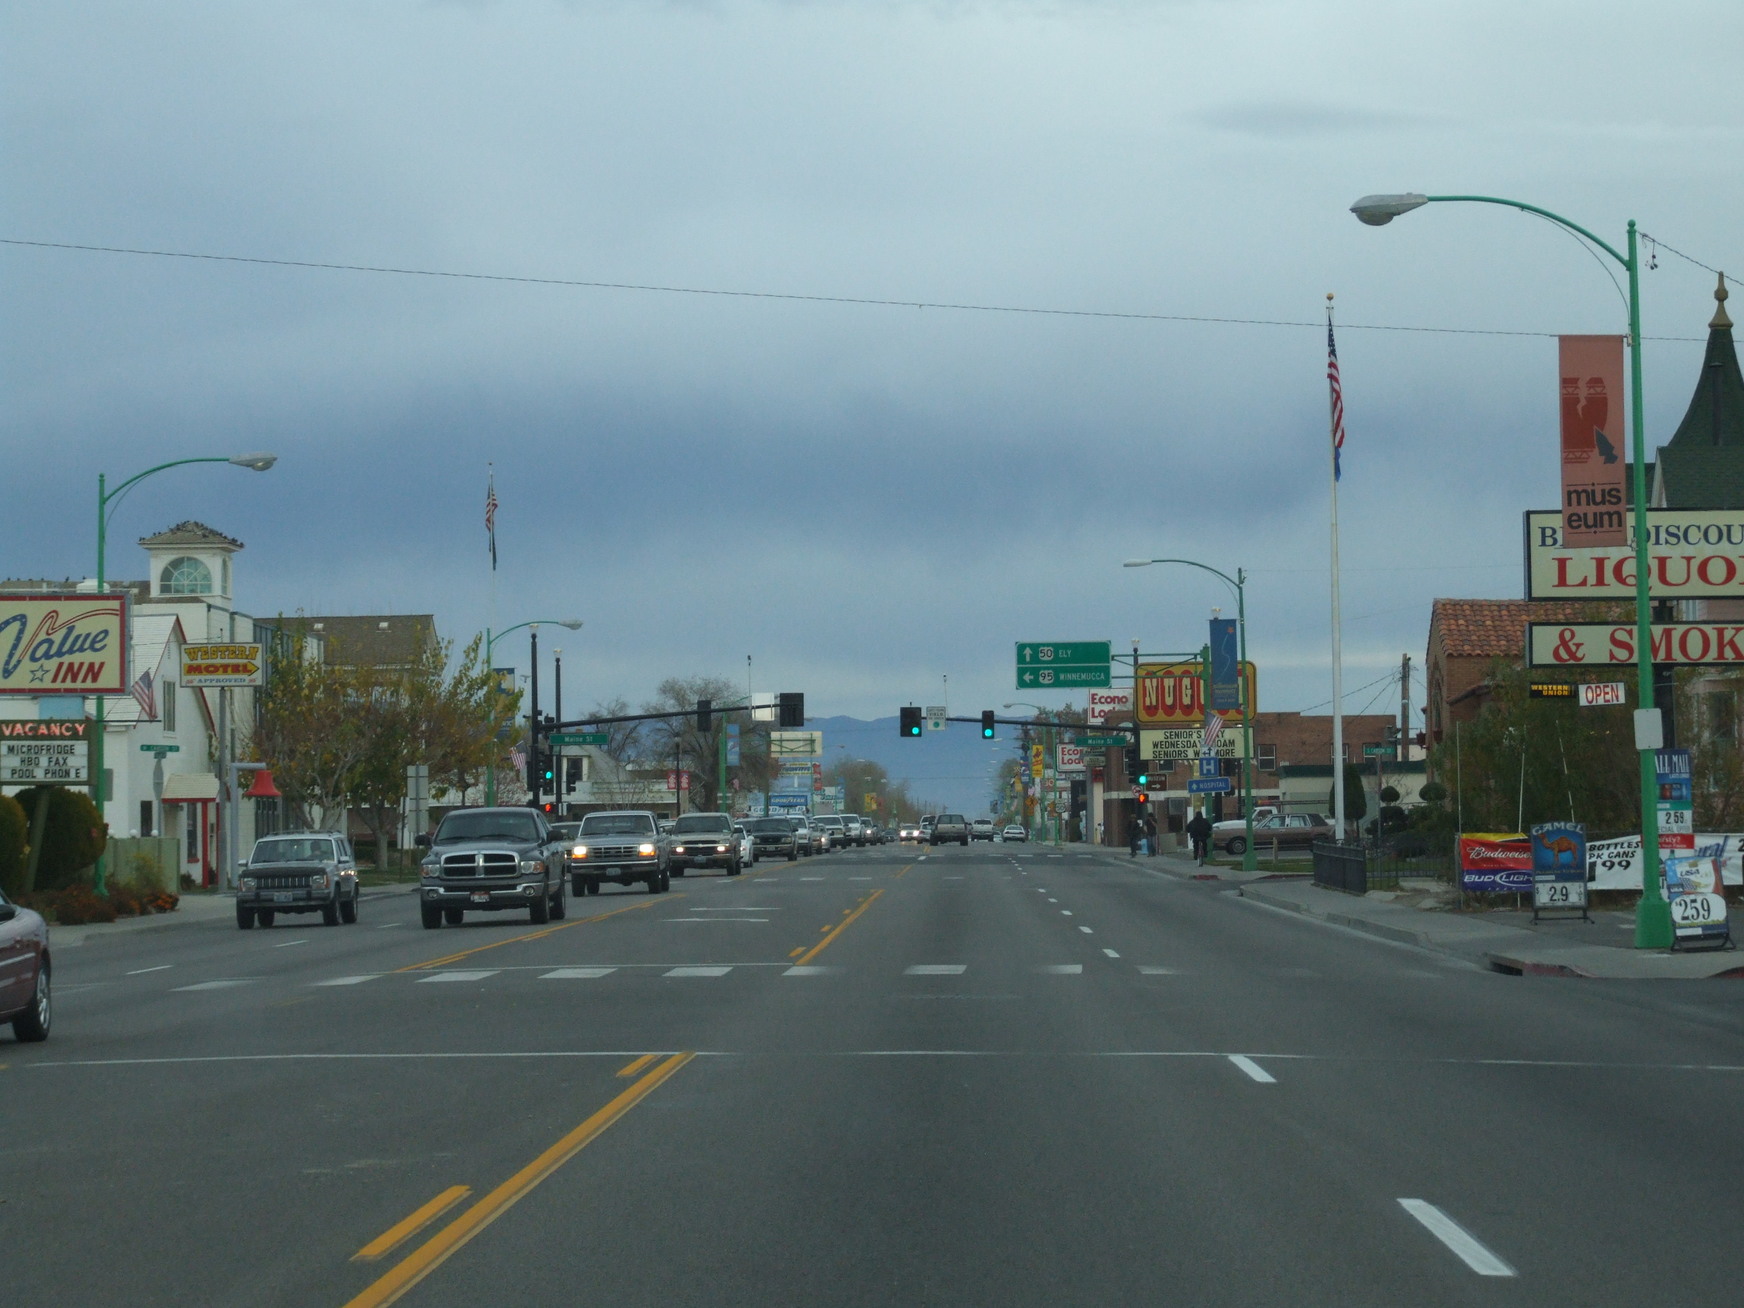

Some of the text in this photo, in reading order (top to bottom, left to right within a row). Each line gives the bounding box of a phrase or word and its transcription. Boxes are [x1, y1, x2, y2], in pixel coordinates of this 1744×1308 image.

[1567, 487, 1621, 507] mus
[1567, 510, 1622, 529] eum
[1552, 555, 1744, 592] LIQUO
[0, 609, 118, 679] Value
[1552, 627, 1586, 663] &
[184, 646, 259, 660] WESTERN
[1039, 648, 1072, 658] 50 ELY
[51, 661, 105, 684] INN
[186, 664, 252, 674] MOTEL
[1040, 672, 1105, 682] 95 WINNEMUCCA
[1091, 693, 1128, 704] Econo
[1585, 684, 1619, 704] OPEN
[1, 722, 86, 736] VACANCY
[1164, 730, 1201, 739] SENIOR'S
[7, 745, 75, 755] MICROFRIDGE
[1152, 750, 1188, 759] SENIORS
[20, 757, 68, 766] HBO FAX
[1203, 760, 1214, 774] H
[11, 769, 36, 779] POOL
[1200, 781, 1226, 789] HOSPITAL
[1533, 822, 1585, 836] CAMEL
[1588, 841, 1641, 852] BOTTLES
[1467, 846, 1532, 861] Budweise
[1607, 850, 1637, 859] CANS
